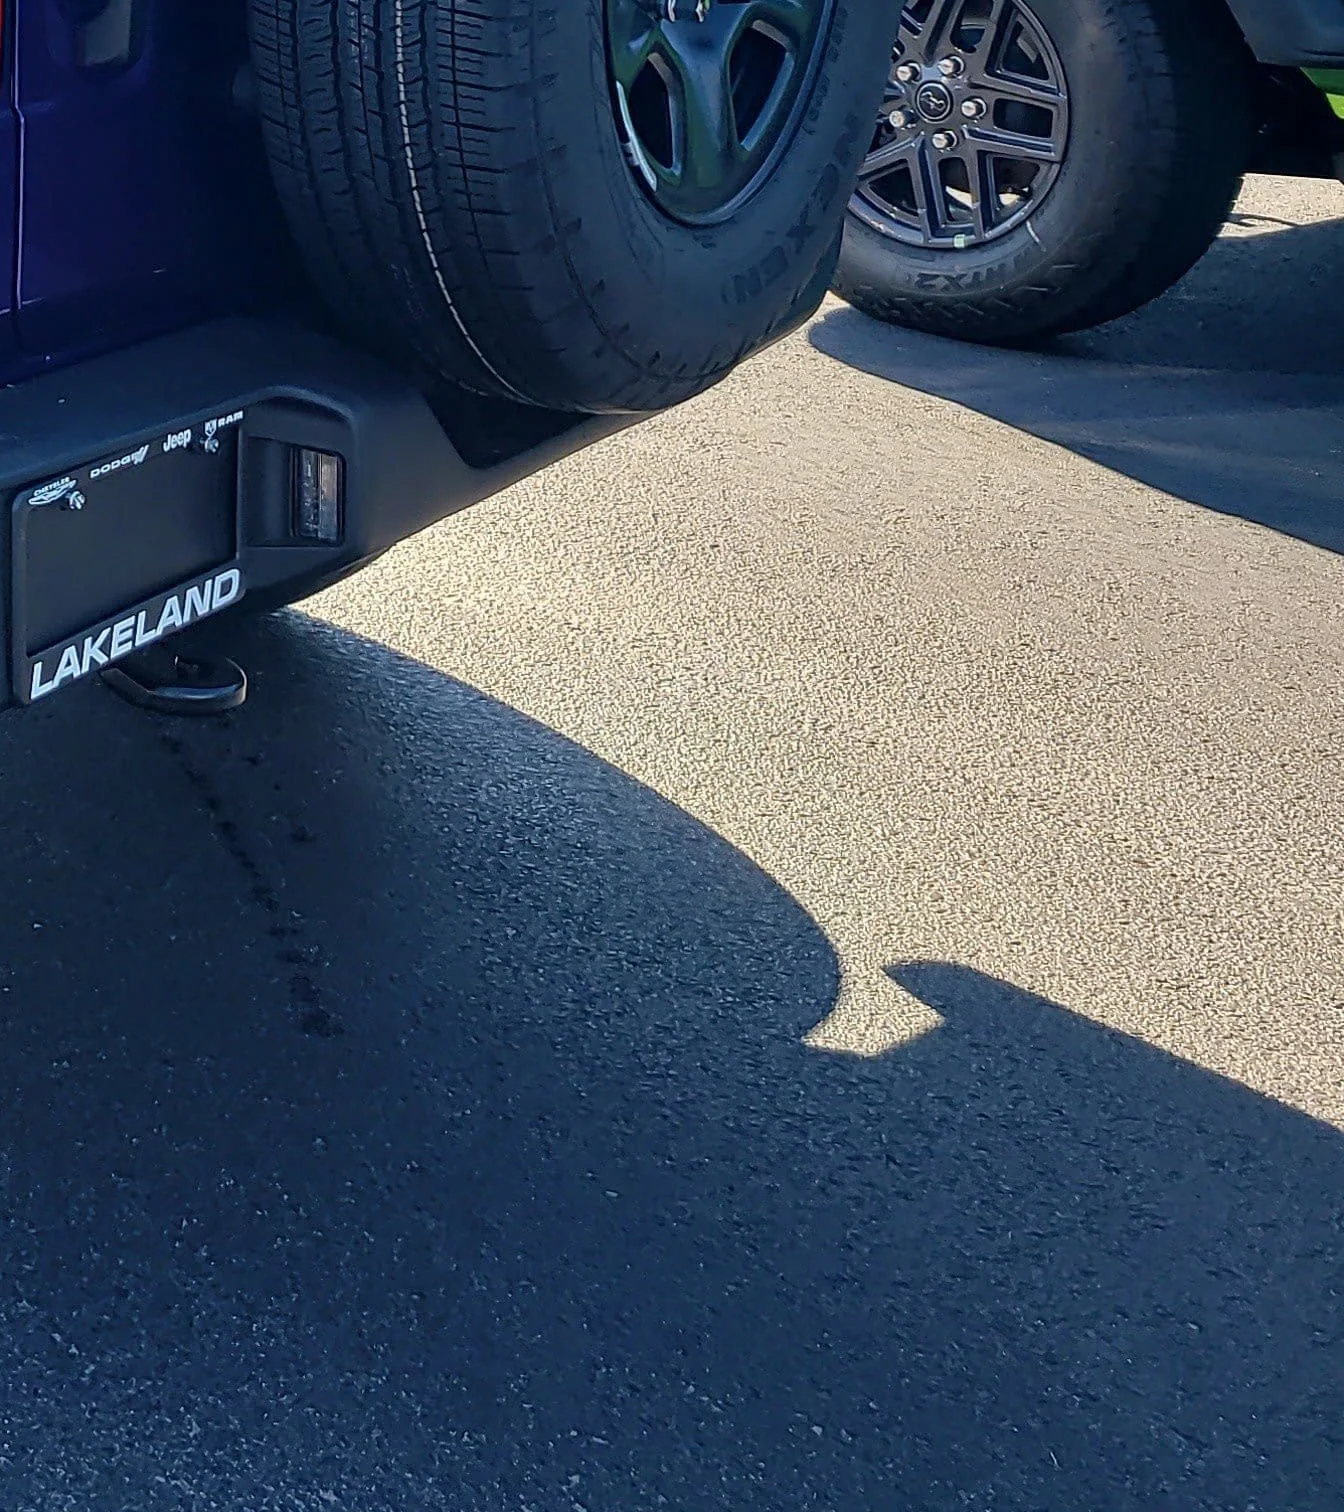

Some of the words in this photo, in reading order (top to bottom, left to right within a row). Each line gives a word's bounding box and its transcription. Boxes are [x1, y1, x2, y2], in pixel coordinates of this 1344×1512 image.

[218, 411, 243, 426] RAM
[162, 429, 192, 453] Jeep
[30, 568, 241, 700] LAKELAND
